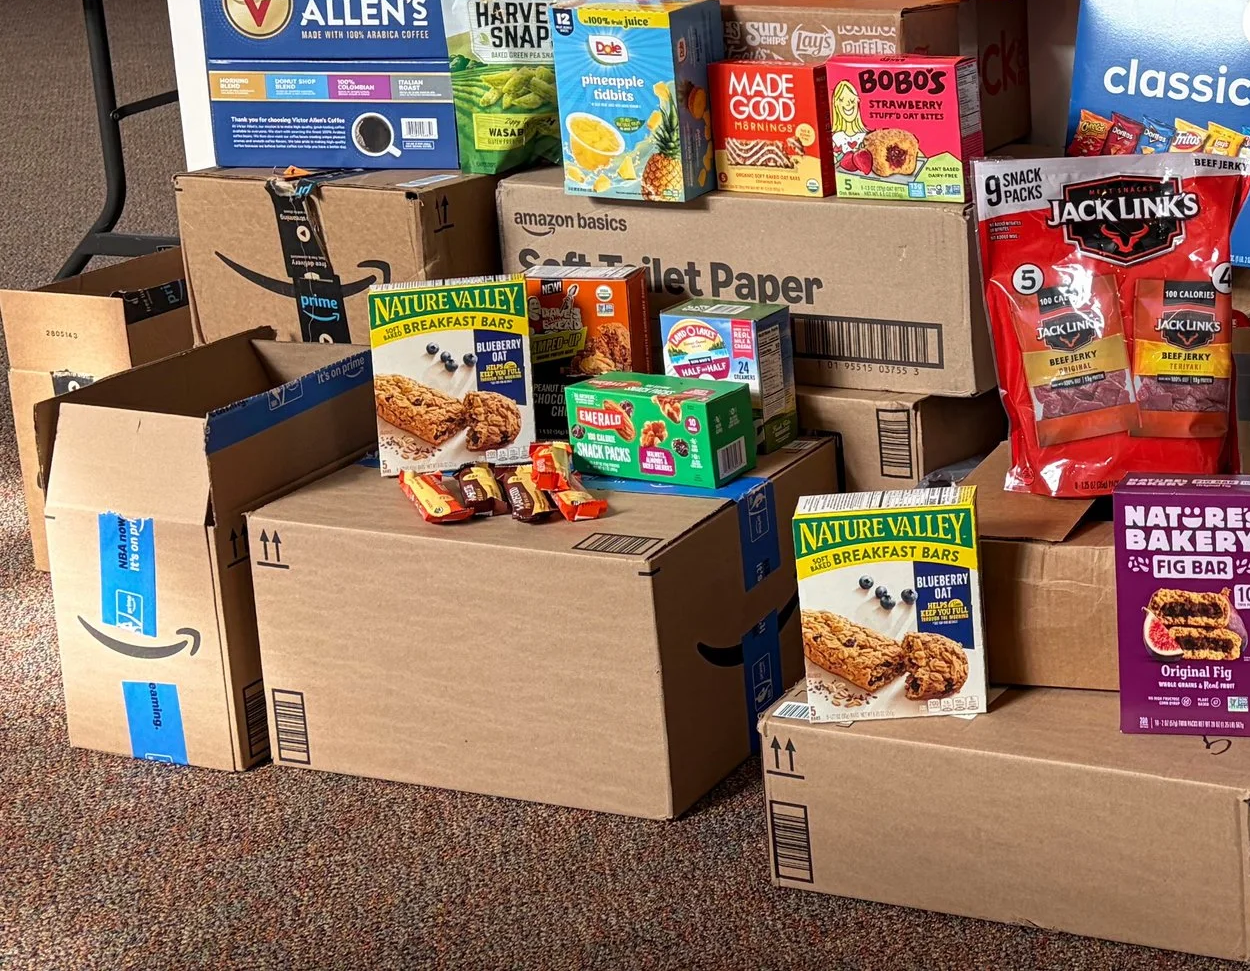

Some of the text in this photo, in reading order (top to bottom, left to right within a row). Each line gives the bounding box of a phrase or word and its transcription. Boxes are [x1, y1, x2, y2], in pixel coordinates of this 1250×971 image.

[475, 2, 554, 27] HARVE
[556, 12, 570, 25] 12
[301, 30, 429, 39] MADE WITH 100% ARABICA COFFEE
[491, 26, 554, 49] SNAP
[760, 36, 788, 45] CHIPS
[596, 41, 622, 54] Dole
[582, 74, 644, 89] pineapple
[729, 72, 794, 96] MADE
[858, 68, 947, 95] BOBO'S
[594, 90, 634, 102] tidbits
[729, 97, 794, 123] GOOD
[868, 99, 943, 110] STRAWBERRY
[268, 116, 291, 124] choosing
[868, 112, 944, 121] STUFF'D OAT BITES
[1194, 158, 1247, 170] BEEF JERKY
[844, 178, 852, 190] 5
[1003, 167, 1043, 187] SNACK
[985, 175, 1003, 206] 9
[1005, 185, 1043, 204] PACKS
[1048, 192, 1199, 226] JACK LINK'S
[514, 211, 627, 232] amazon basics
[710, 262, 824, 305] Paper
[1021, 269, 1036, 290] 5
[1219, 266, 1232, 287] 4
[542, 282, 562, 294] NEW!
[1165, 290, 1215, 300] 100 CALORIES
[300, 294, 338, 309] prime
[374, 287, 519, 326] NATURE VALLEY
[404, 316, 514, 335] BREAKFAST BARS
[1154, 318, 1221, 332] JACK LINK'S
[383, 331, 402, 341] BAKED
[476, 338, 521, 352] BLUEBERRY
[492, 352, 507, 362] OAT
[1050, 350, 1097, 367] BEEF JERKY
[1161, 352, 1211, 361] BEEF JERKY
[317, 356, 365, 385] It's on prime
[681, 363, 726, 376] HALF HALF
[738, 361, 749, 374] 24
[1170, 362, 1201, 371] TERIYAKI
[579, 409, 620, 426] EMERALD
[576, 442, 631, 463] SNACK PACKS
[799, 513, 965, 554] NATURE VALLEY
[117, 517, 128, 569] NBA now
[812, 556, 828, 565] SOFT
[833, 546, 960, 565] BREAKFAST BARS
[810, 561, 832, 572] BAKED
[1157, 560, 1228, 575] FIG BAR
[917, 573, 969, 588] BLUEBERRY
[935, 588, 952, 599] OAT
[921, 606, 969, 617] KEEP YOU FULL
[927, 601, 947, 609] HELPS
[1161, 664, 1232, 681] Original Fig
